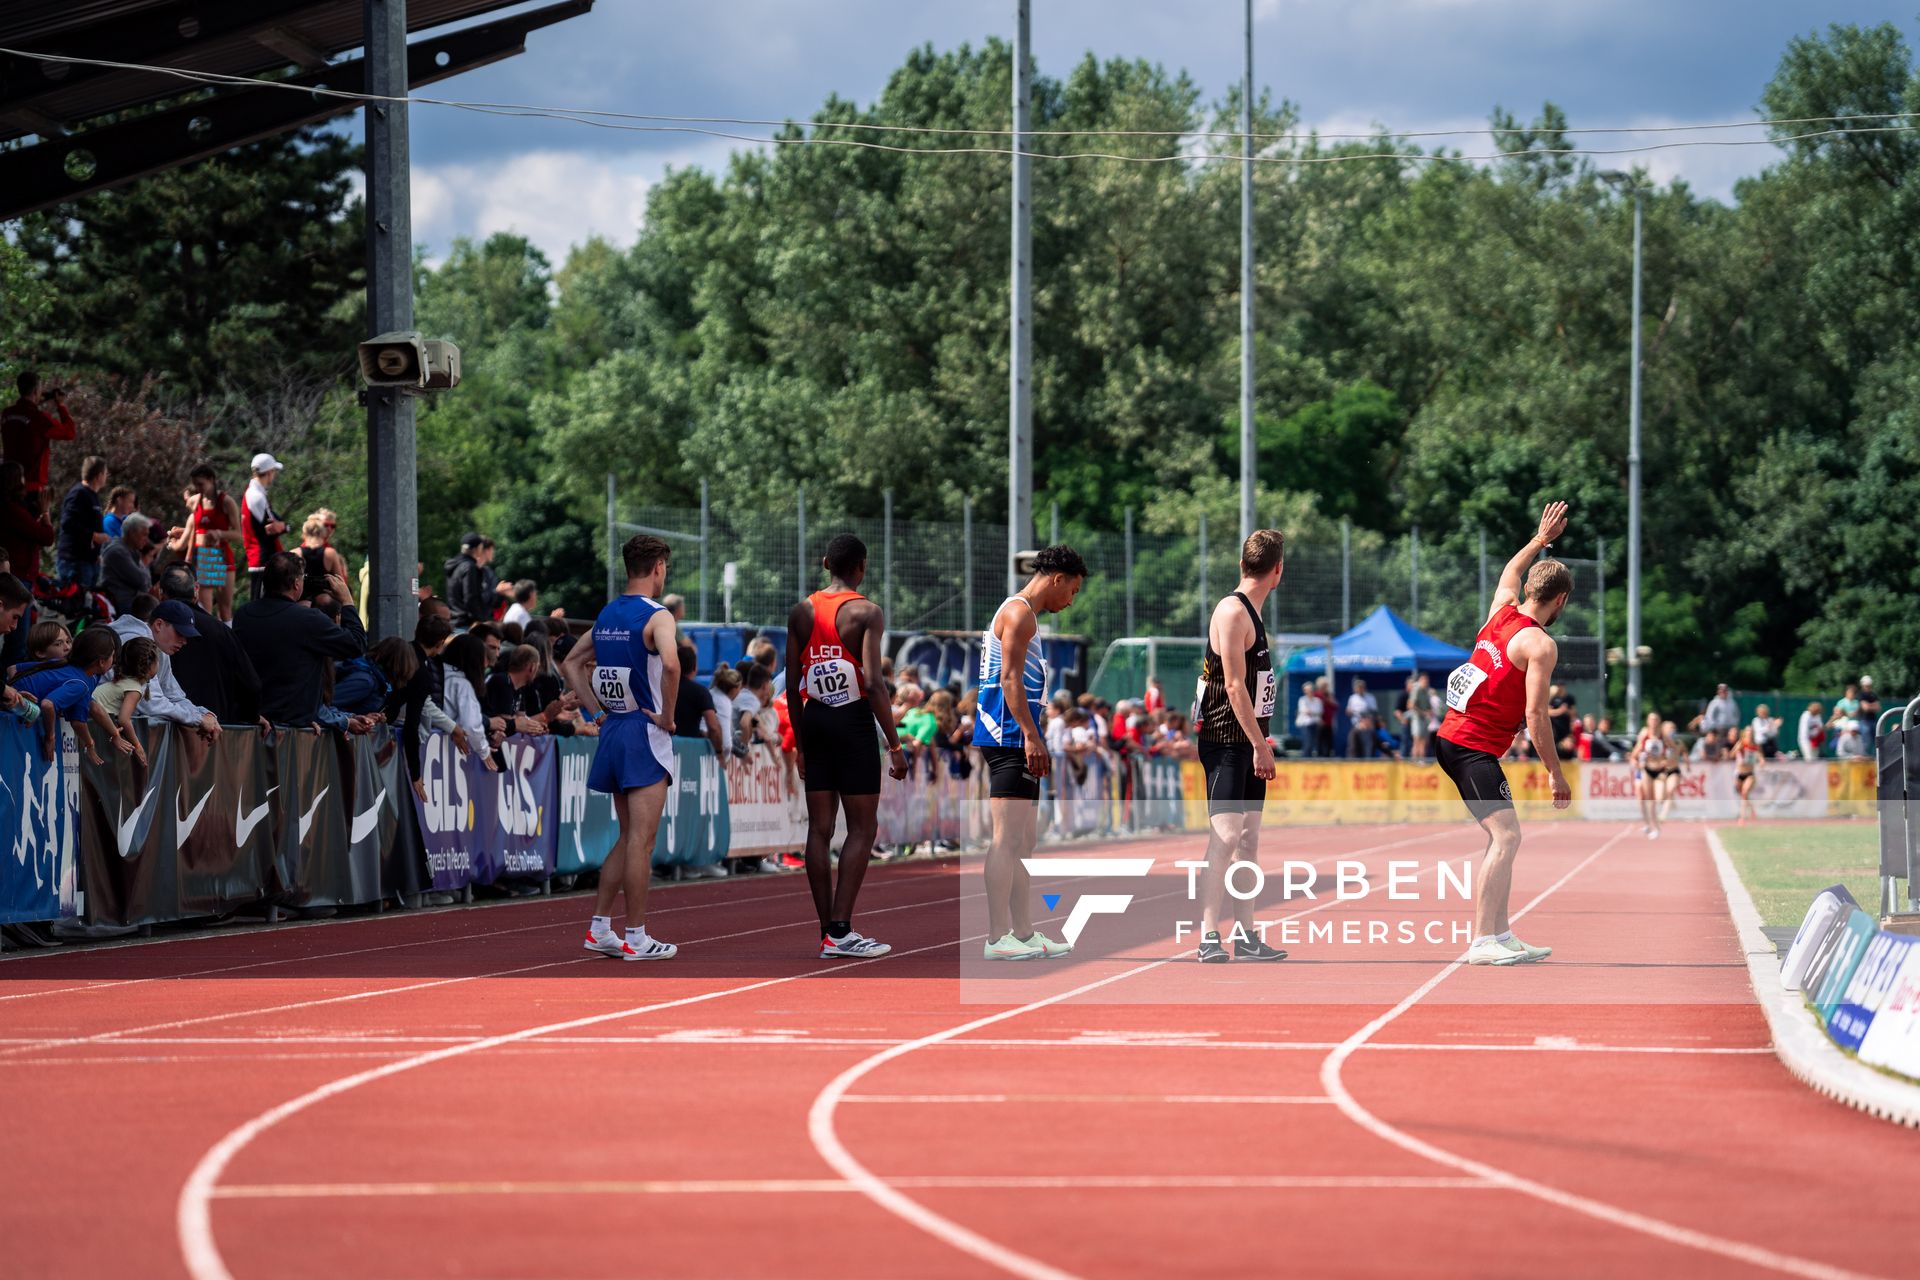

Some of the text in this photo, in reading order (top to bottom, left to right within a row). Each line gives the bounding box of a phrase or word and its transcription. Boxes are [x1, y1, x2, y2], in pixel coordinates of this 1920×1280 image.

[810, 645, 842, 659] LGO
[599, 669, 617, 680] GLS
[813, 672, 849, 694] 102
[599, 681, 625, 699] 420
[1449, 673, 1472, 695] 465
